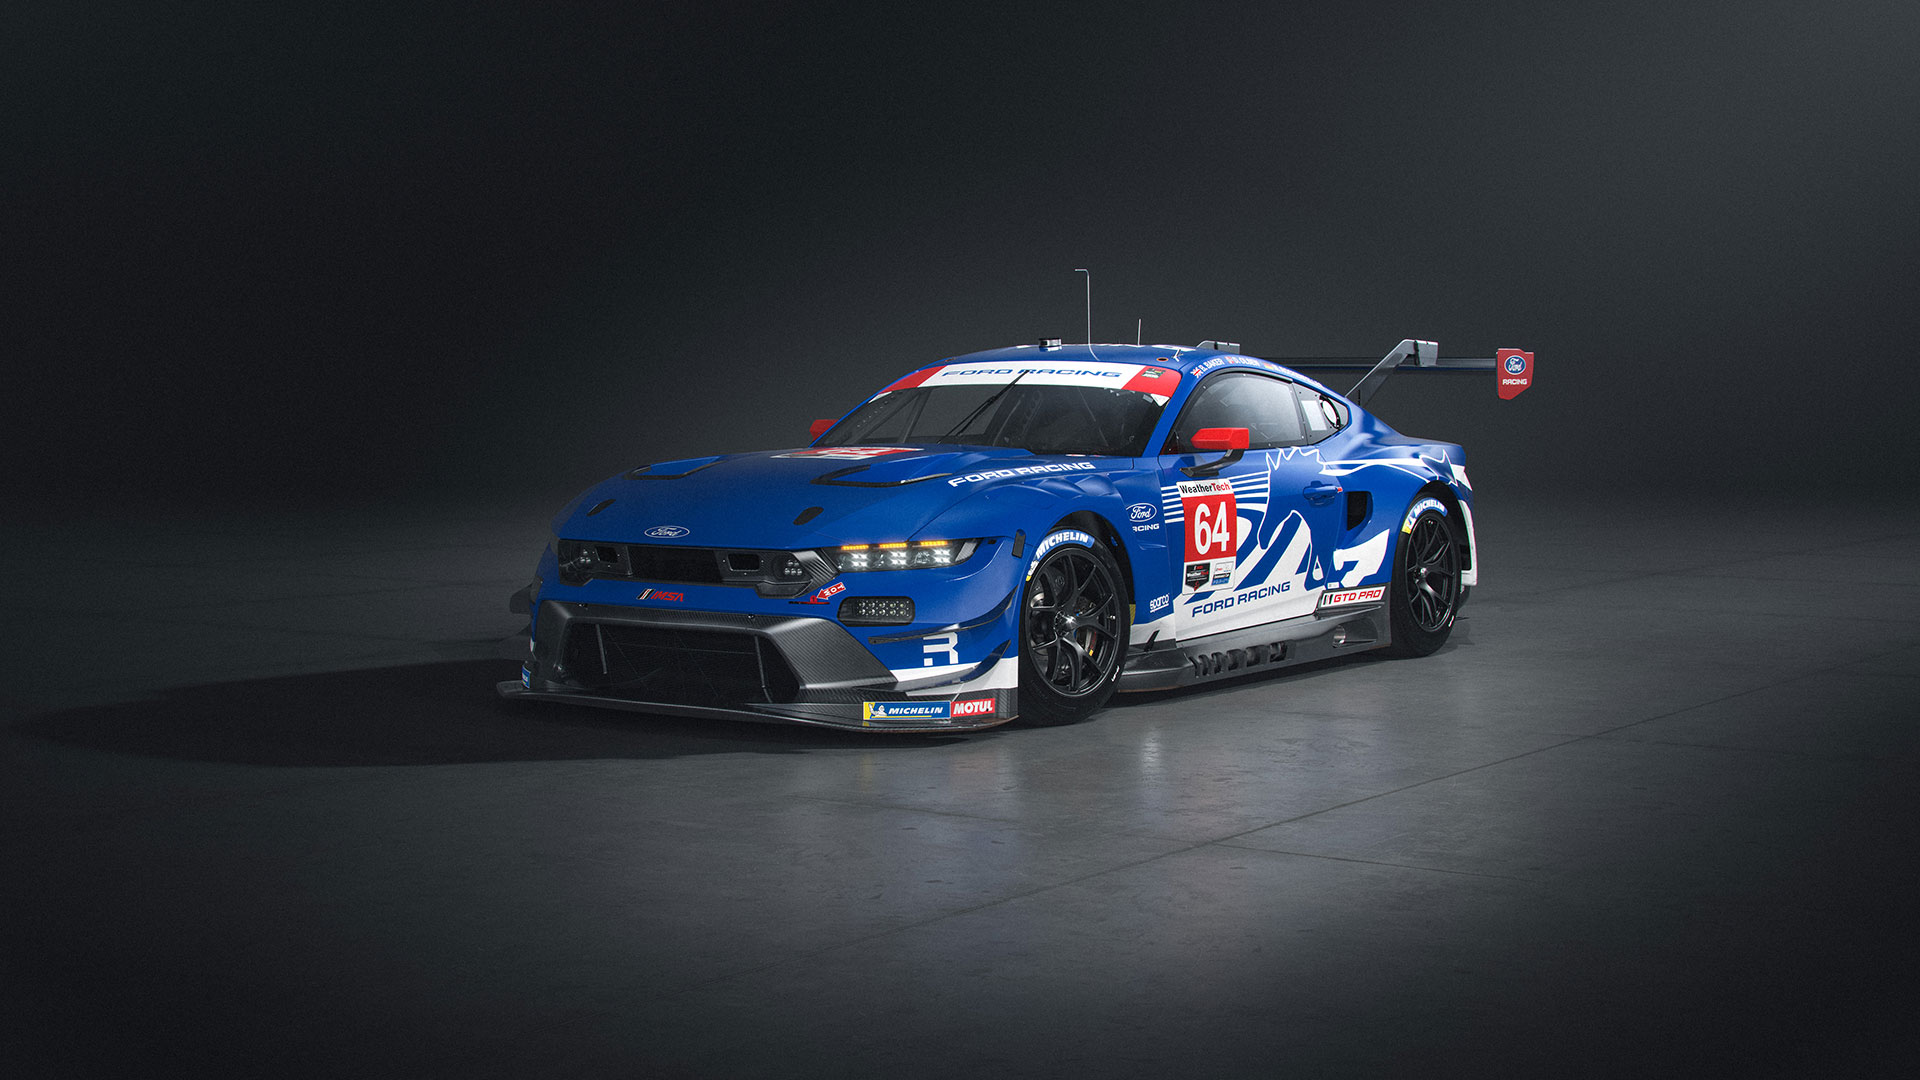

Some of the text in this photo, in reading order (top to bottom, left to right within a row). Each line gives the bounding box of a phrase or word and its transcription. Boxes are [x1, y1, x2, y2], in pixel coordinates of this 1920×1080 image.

[942, 368, 1122, 378] FORD RACING
[947, 461, 1096, 487] FORD RACING
[1179, 482, 1231, 494] WeatherTech
[1130, 505, 1152, 519] Ford
[1413, 499, 1445, 517] MICHELIN
[1194, 501, 1230, 555] 64
[1035, 531, 1089, 560] MICHELIN
[650, 590, 684, 602] IMSA
[1191, 581, 1291, 617] FORD RACING
[1357, 589, 1382, 600] PRO
[888, 707, 944, 715] MICHELIN
[953, 700, 994, 715] MOTUL
